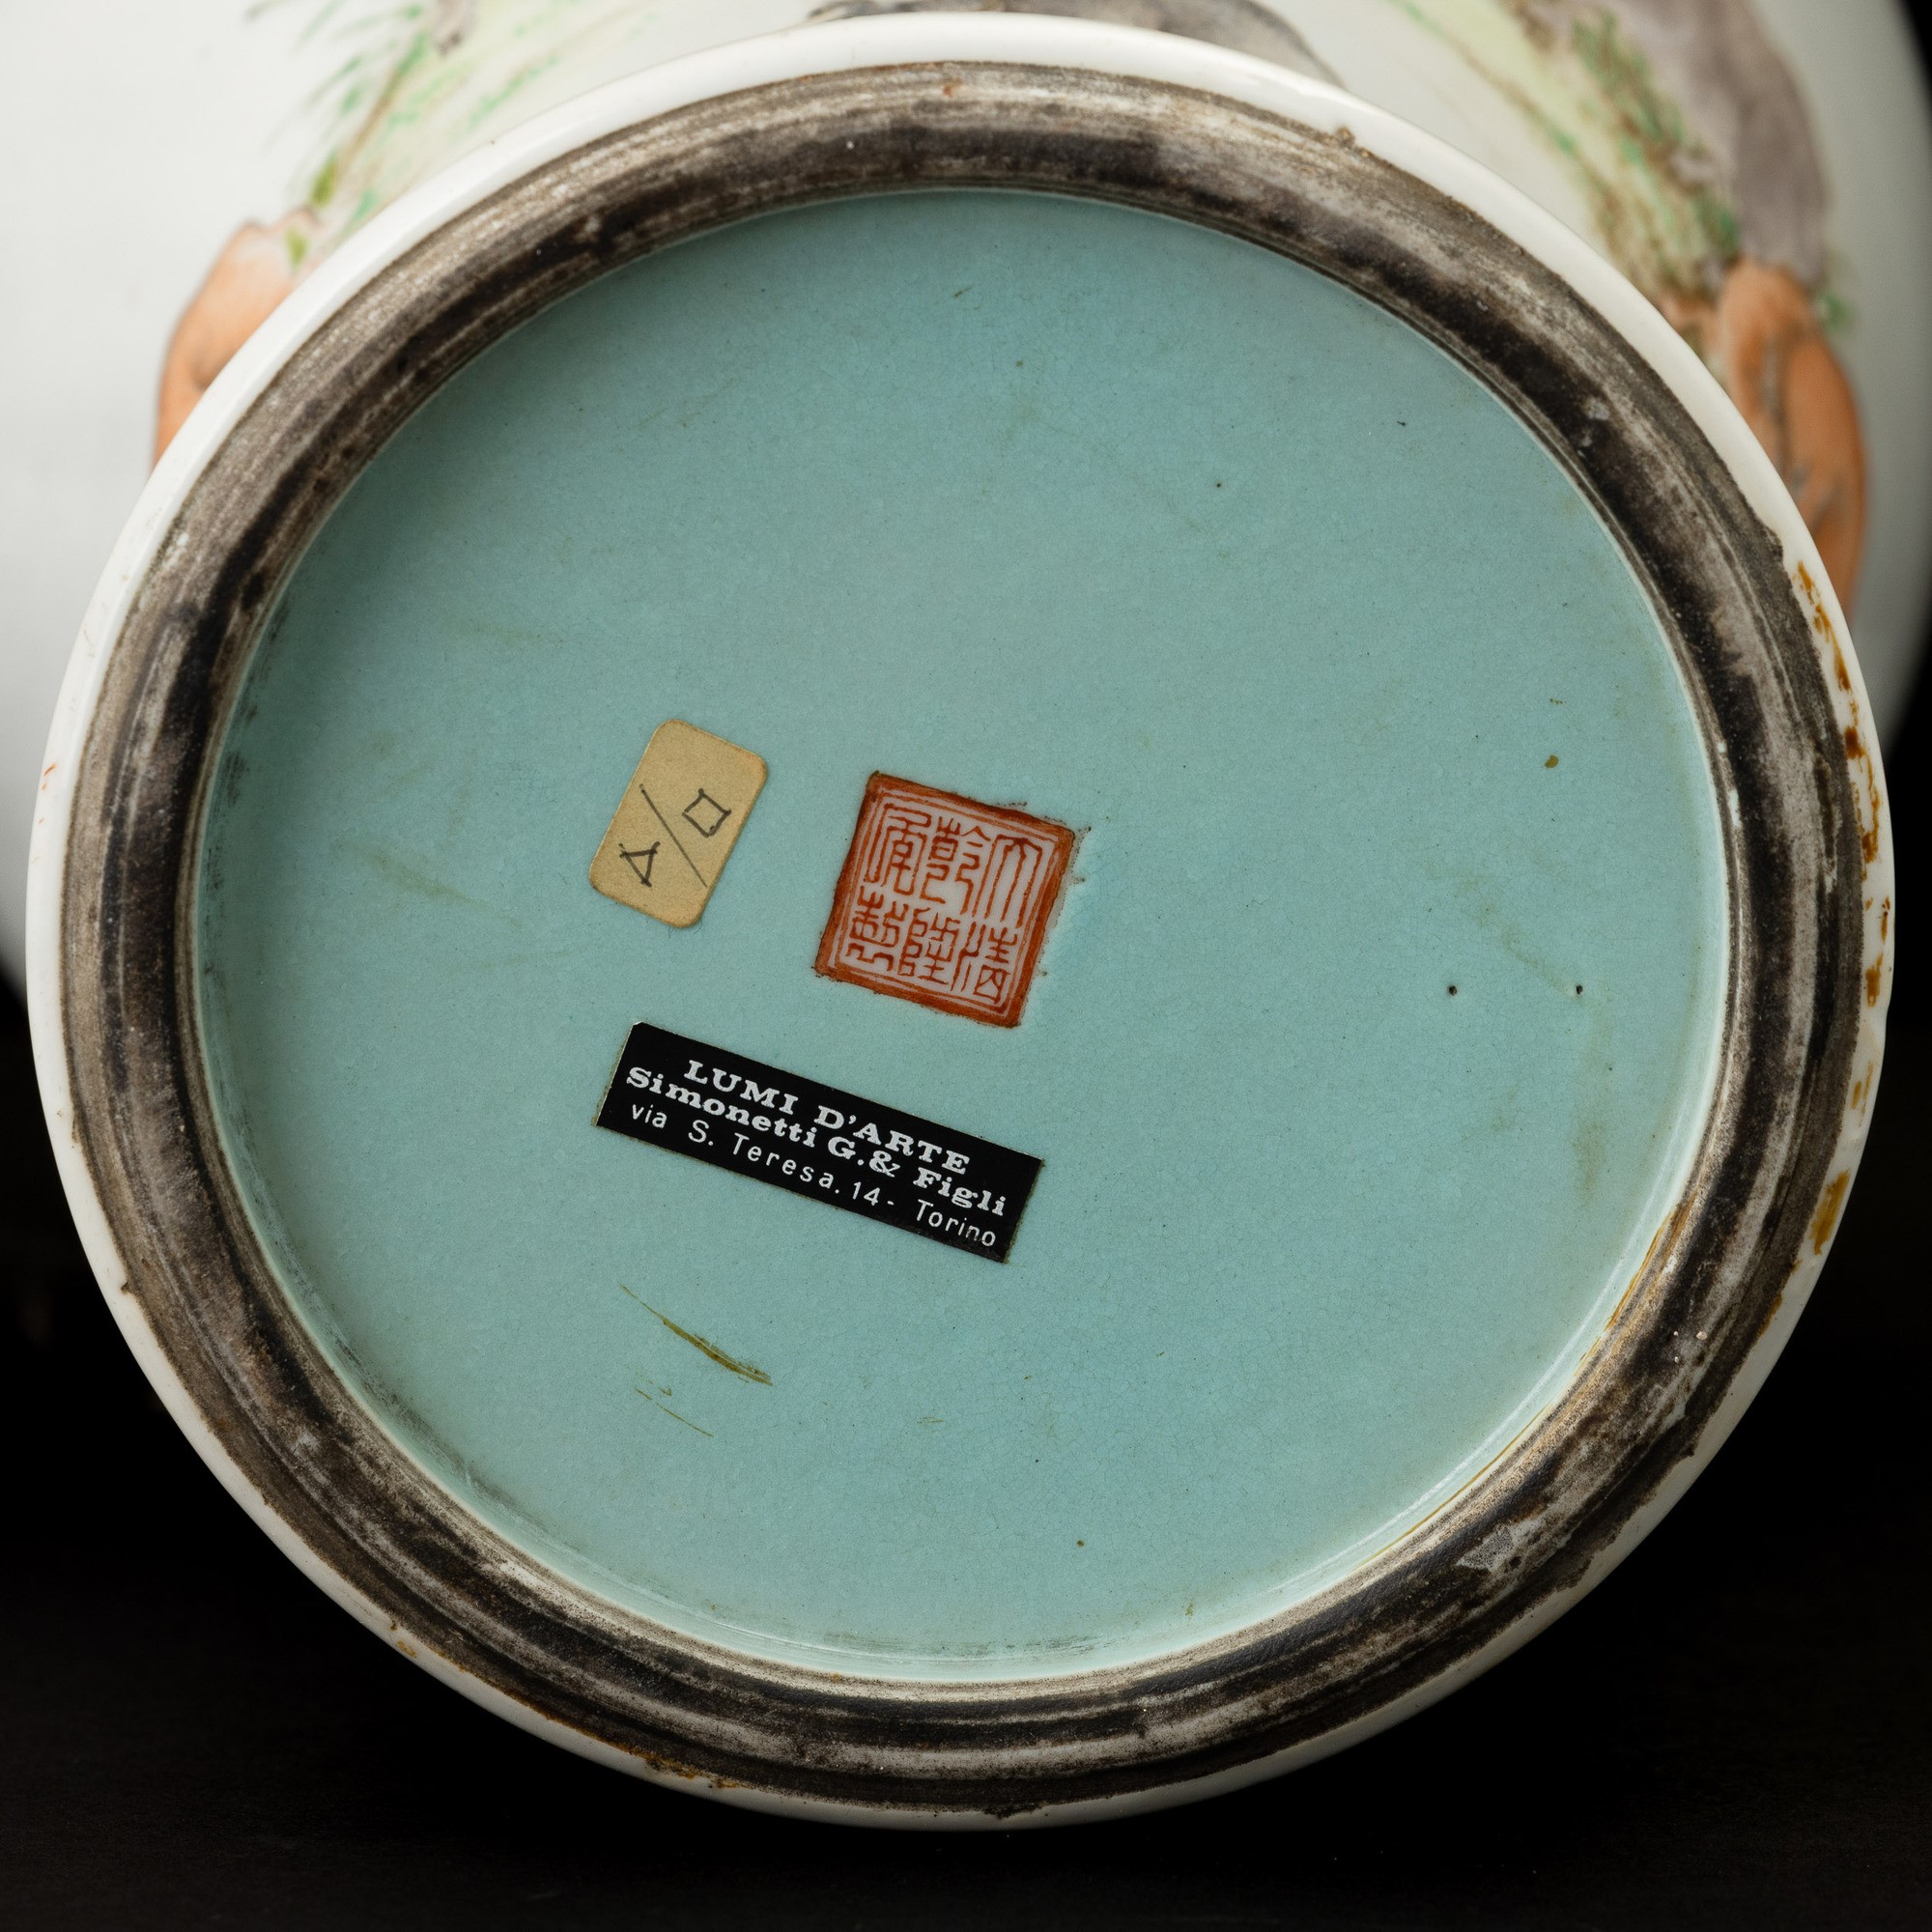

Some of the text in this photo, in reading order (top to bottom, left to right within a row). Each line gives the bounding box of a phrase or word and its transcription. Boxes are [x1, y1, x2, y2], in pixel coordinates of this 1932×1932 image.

[626, 1067, 818, 1149] Simonetti
[913, 1167, 1007, 1217] Figli
[631, 1103, 668, 1130] via
[689, 1120, 715, 1148] S.
[916, 1198, 997, 1248] Torino
[684, 1060, 971, 1176] LUMI D'ARTE
